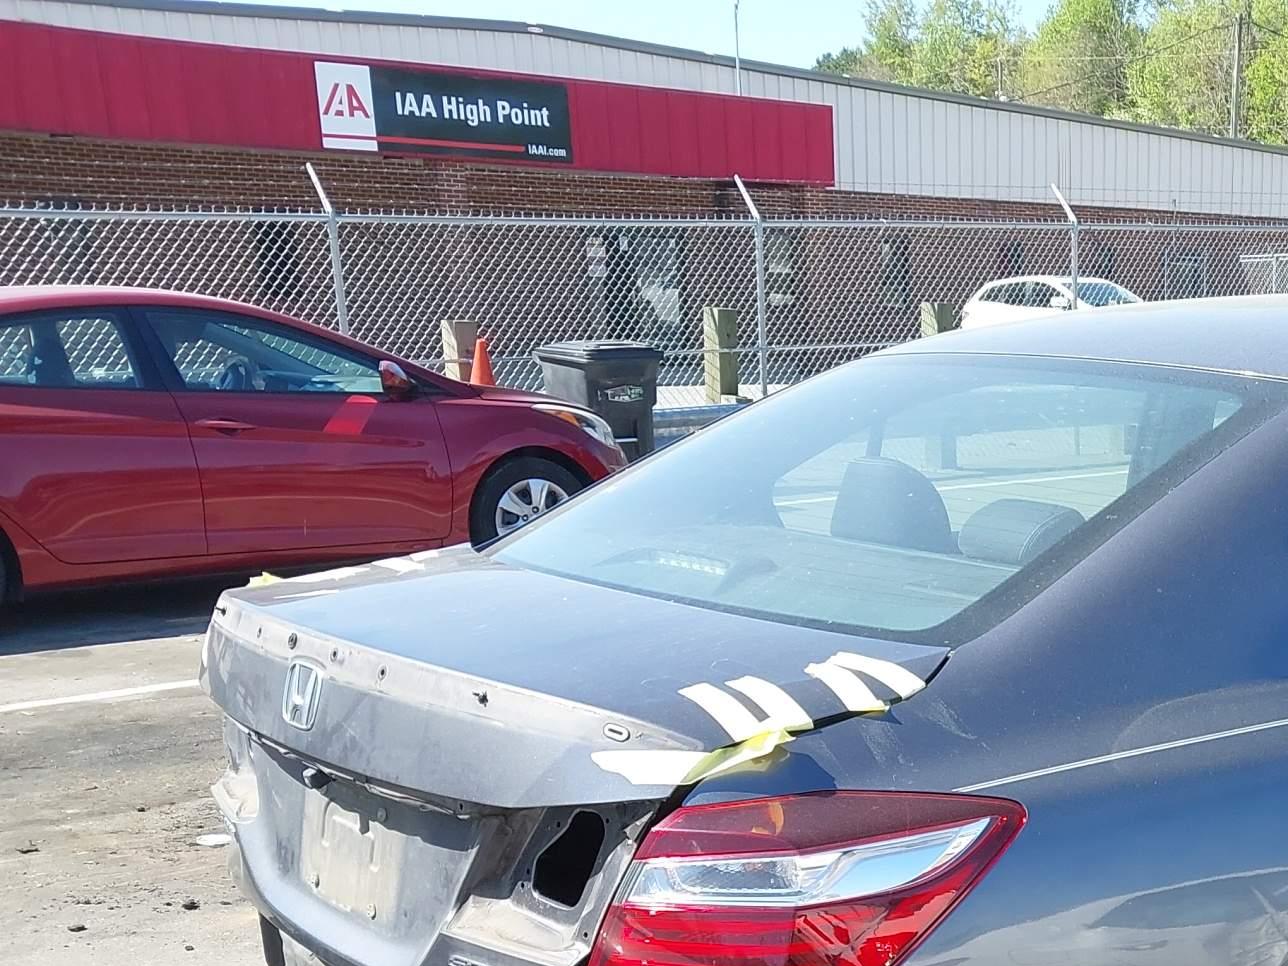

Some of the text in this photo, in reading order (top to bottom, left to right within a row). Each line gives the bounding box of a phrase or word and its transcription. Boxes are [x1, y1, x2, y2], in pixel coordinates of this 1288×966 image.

[394, 91, 551, 127] IAA High Point
[527, 143, 567, 157] IAAI.com
